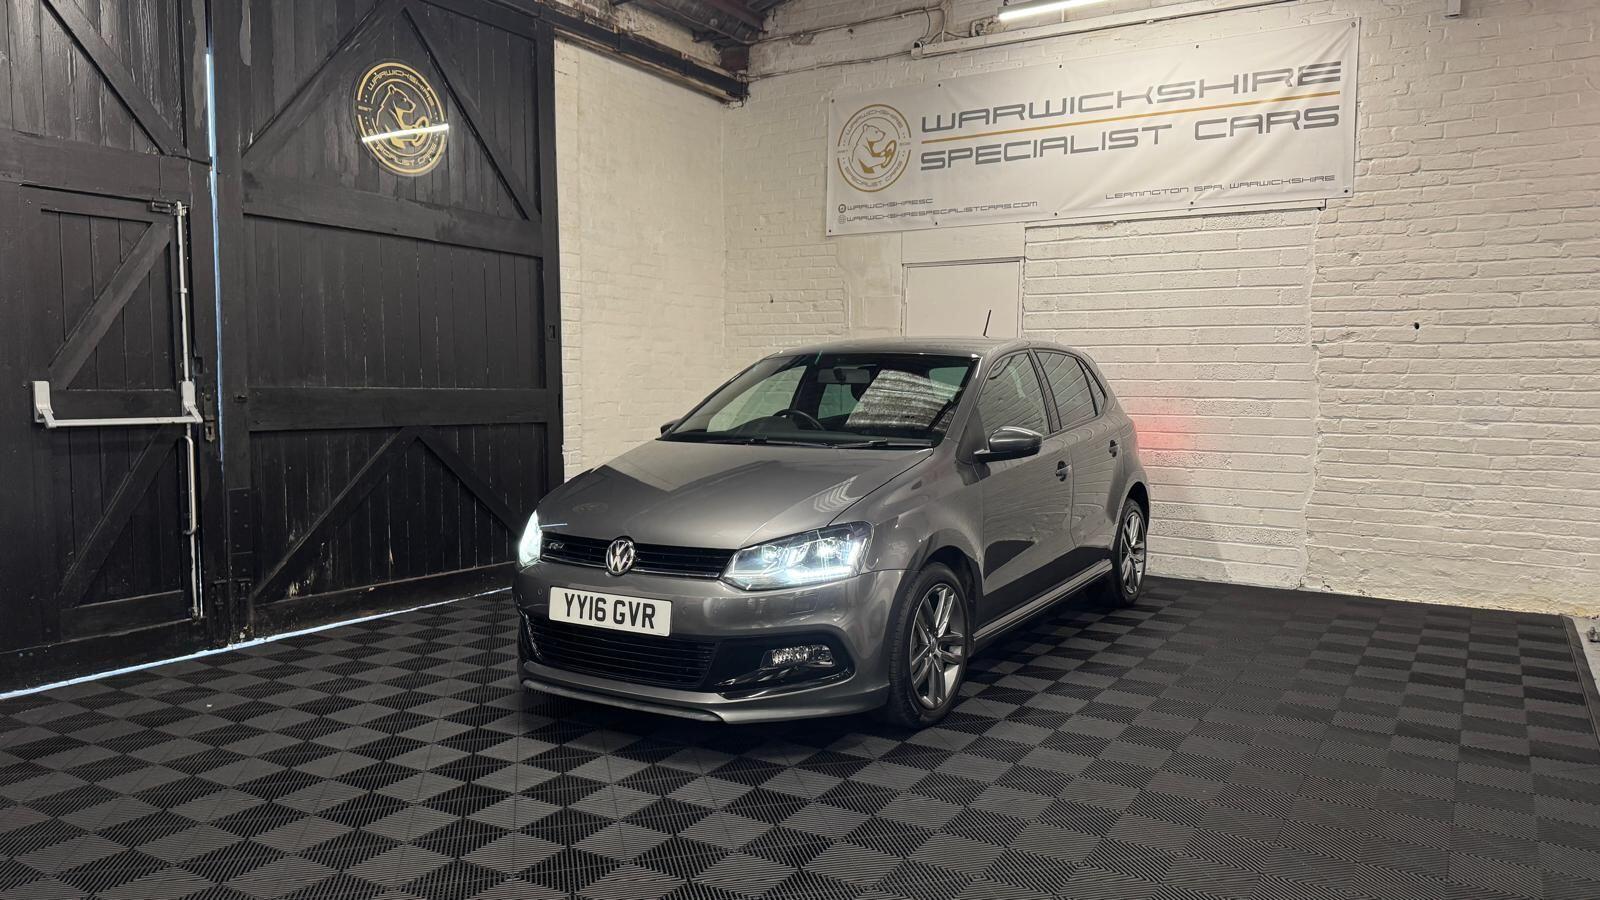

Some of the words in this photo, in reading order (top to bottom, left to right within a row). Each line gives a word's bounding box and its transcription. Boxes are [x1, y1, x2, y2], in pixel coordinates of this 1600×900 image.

[367, 69, 435, 107] WARWICKSHIRE
[922, 61, 1341, 133] WARWICKSHIRE
[921, 124, 1172, 171] SPECIALIST
[1195, 105, 1340, 141] CARS
[1105, 187, 1189, 200] LEAMINGTON
[1229, 174, 1335, 189] WARWICKSHIRE
[564, 593, 607, 622] YY16
[613, 600, 656, 629] GVR
